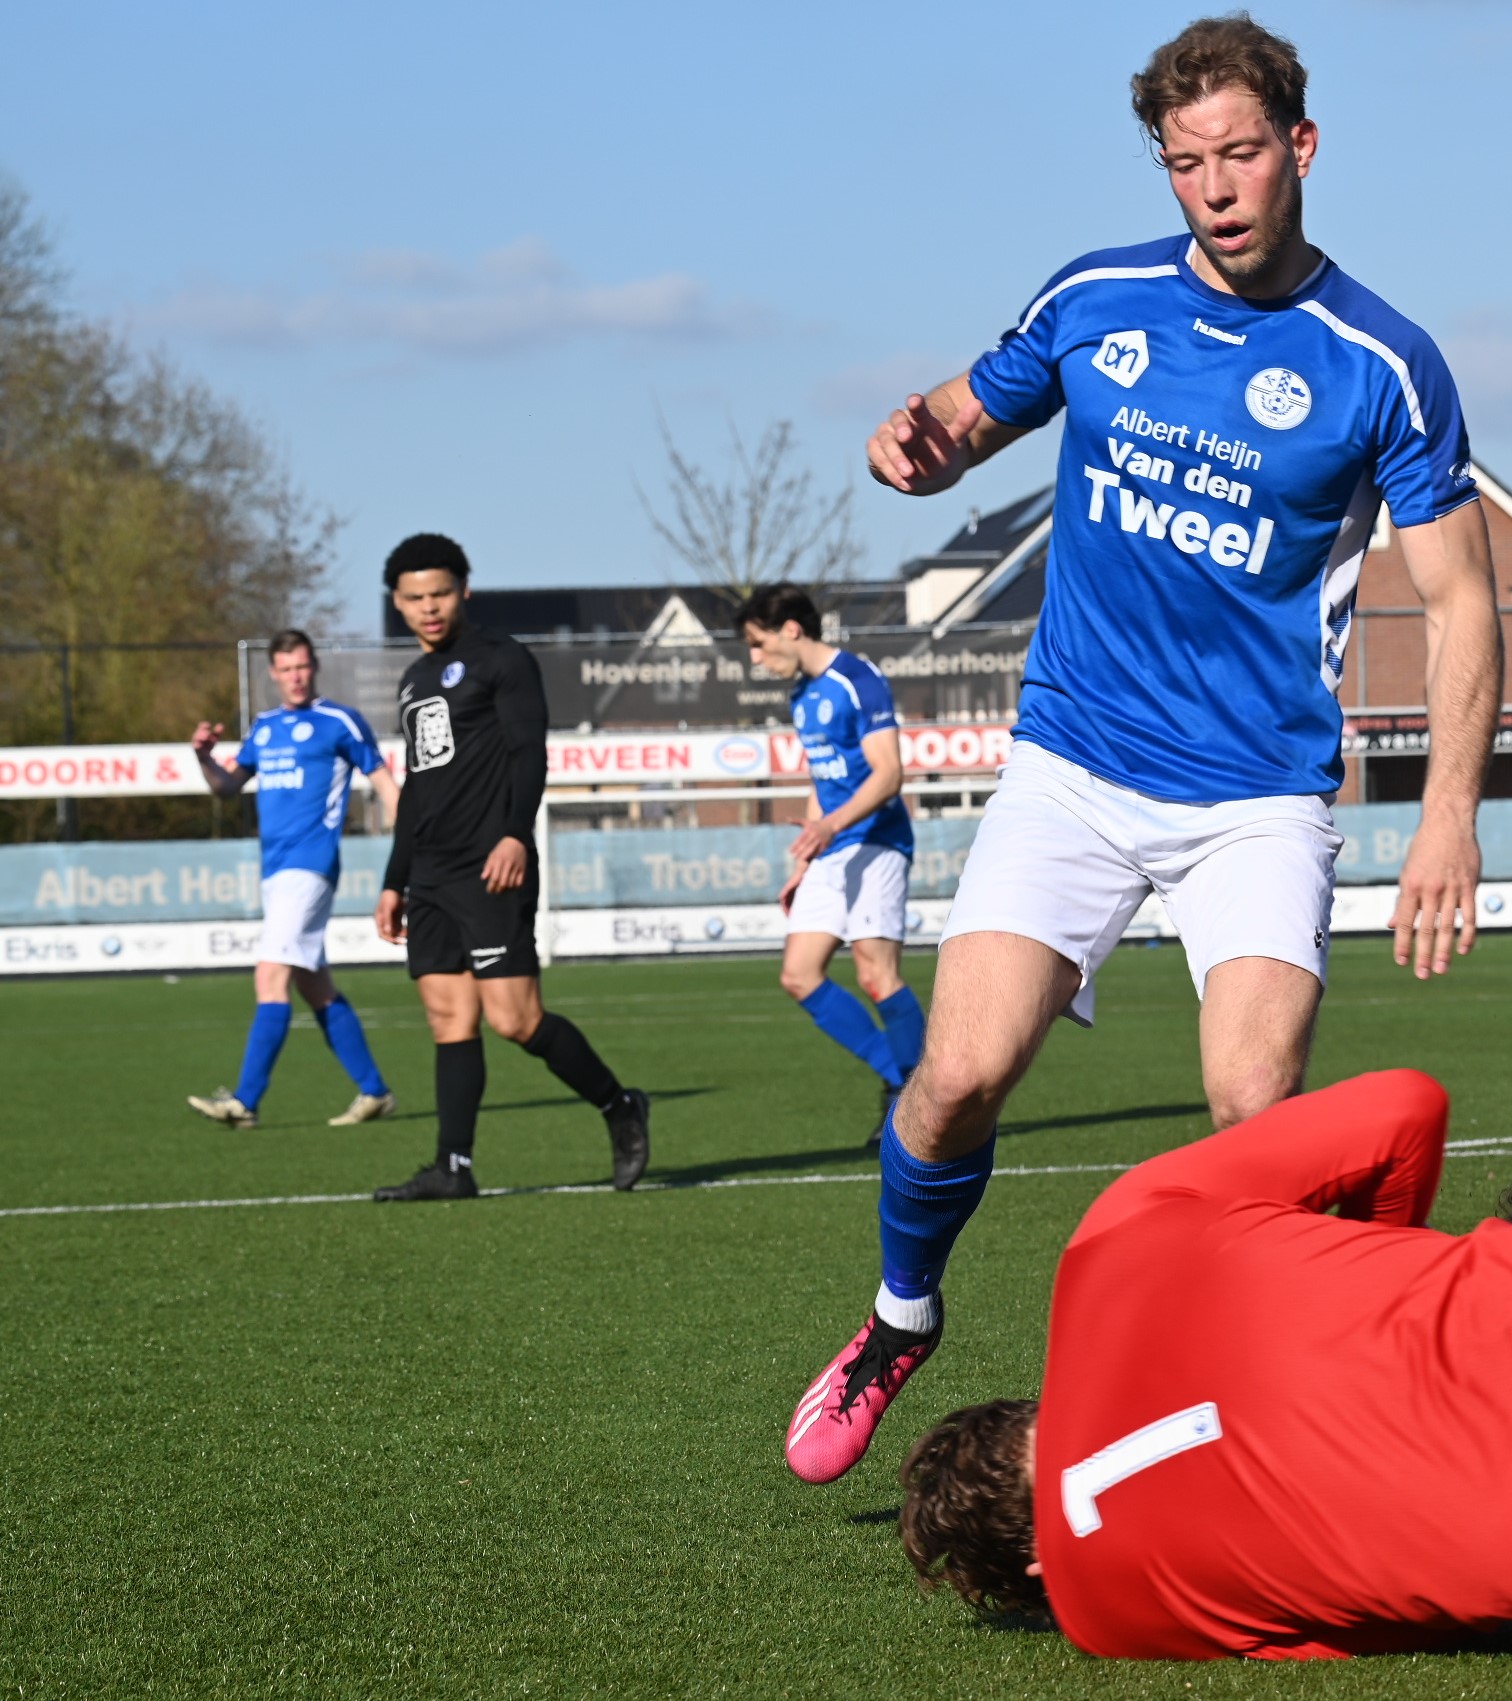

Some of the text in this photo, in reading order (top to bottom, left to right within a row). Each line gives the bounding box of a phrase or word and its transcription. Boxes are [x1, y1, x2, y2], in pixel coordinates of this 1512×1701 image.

[1110, 406, 1262, 471] Albert Heijn
[1107, 437, 1252, 508] Van den
[1084, 464, 1275, 575] Tweel
[581, 656, 710, 685] Hovenier
[156, 756, 181, 782] &
[34, 865, 167, 908] Albert
[180, 863, 262, 911] Heij
[641, 853, 771, 891] Trotse
[209, 930, 260, 956] Ekr
[612, 918, 682, 942] Ekris
[5, 937, 78, 961] Ekris
